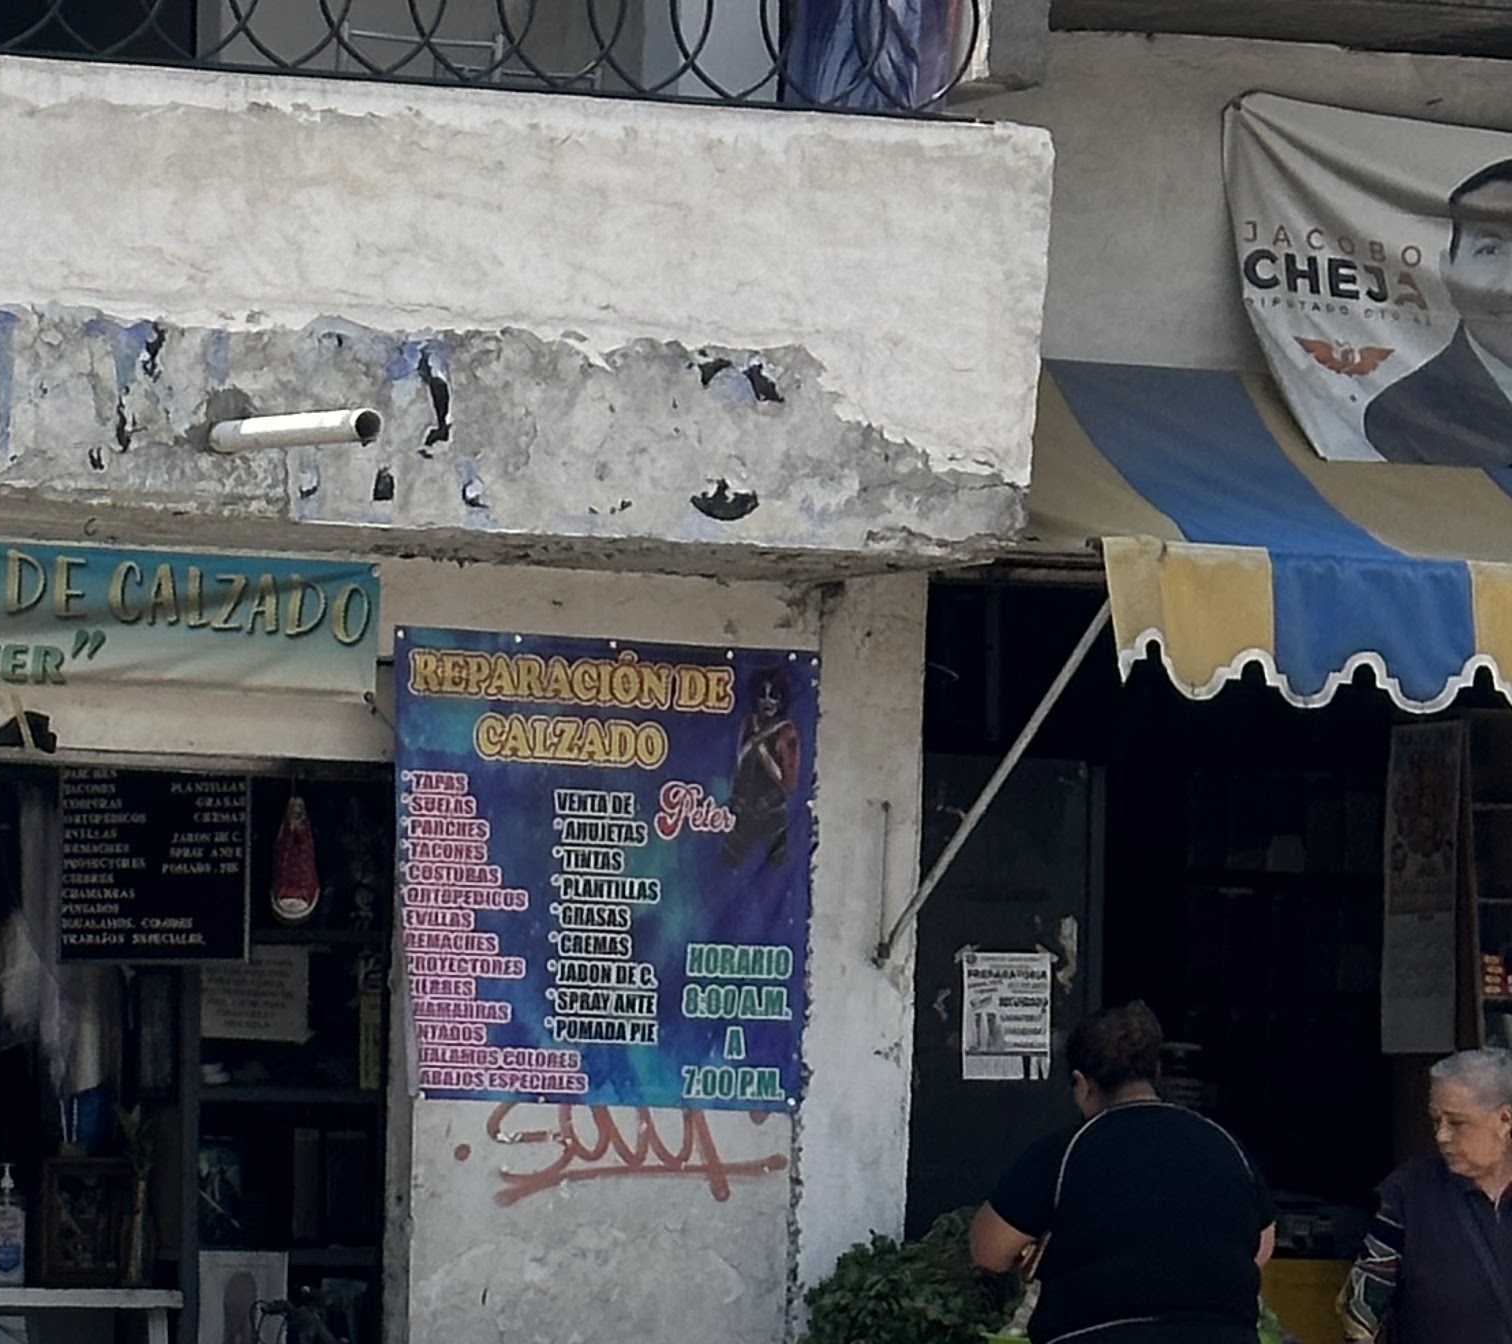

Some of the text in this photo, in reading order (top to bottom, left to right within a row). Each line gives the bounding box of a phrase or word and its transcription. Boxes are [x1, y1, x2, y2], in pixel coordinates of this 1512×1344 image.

[1242, 220, 1424, 269] JACOBO
[1243, 248, 1429, 312] CHEJA
[3, 548, 89, 621] DE
[106, 558, 374, 649] CALZADO
[410, 650, 734, 713] REPARACIÓN DE
[474, 714, 668, 769] CALZADO
[413, 772, 467, 792] TAPAS
[410, 796, 476, 816] SUELAS
[556, 790, 634, 816] VENTA DE
[655, 779, 736, 839] Peter
[409, 817, 489, 839] PARCHES
[409, 840, 487, 861] TACONES
[563, 848, 624, 872] TINTAS
[407, 863, 501, 885] COSTURAS
[406, 885, 527, 909] ORTOPEDICOS
[561, 877, 660, 903] PLANTILLAS
[404, 909, 474, 929] EVILLAS
[560, 904, 630, 929] GRASAS
[404, 932, 498, 953] REMACHES
[559, 933, 631, 958] CREMAS
[688, 944, 791, 978] HORARIO
[615, 963, 638, 986] DE
[413, 1000, 511, 1022] HAMARRAS
[556, 989, 656, 1015] SPRAY ANTE
[684, 986, 737, 1017] 8:00
[418, 1022, 486, 1043] NTADOS
[555, 1017, 657, 1044] POMADA PIE
[725, 1028, 745, 1058] A
[502, 1048, 580, 1070] COLORES
[419, 1068, 587, 1093] ABAJOS ESPECIALES
[683, 1067, 735, 1098] 7:00
